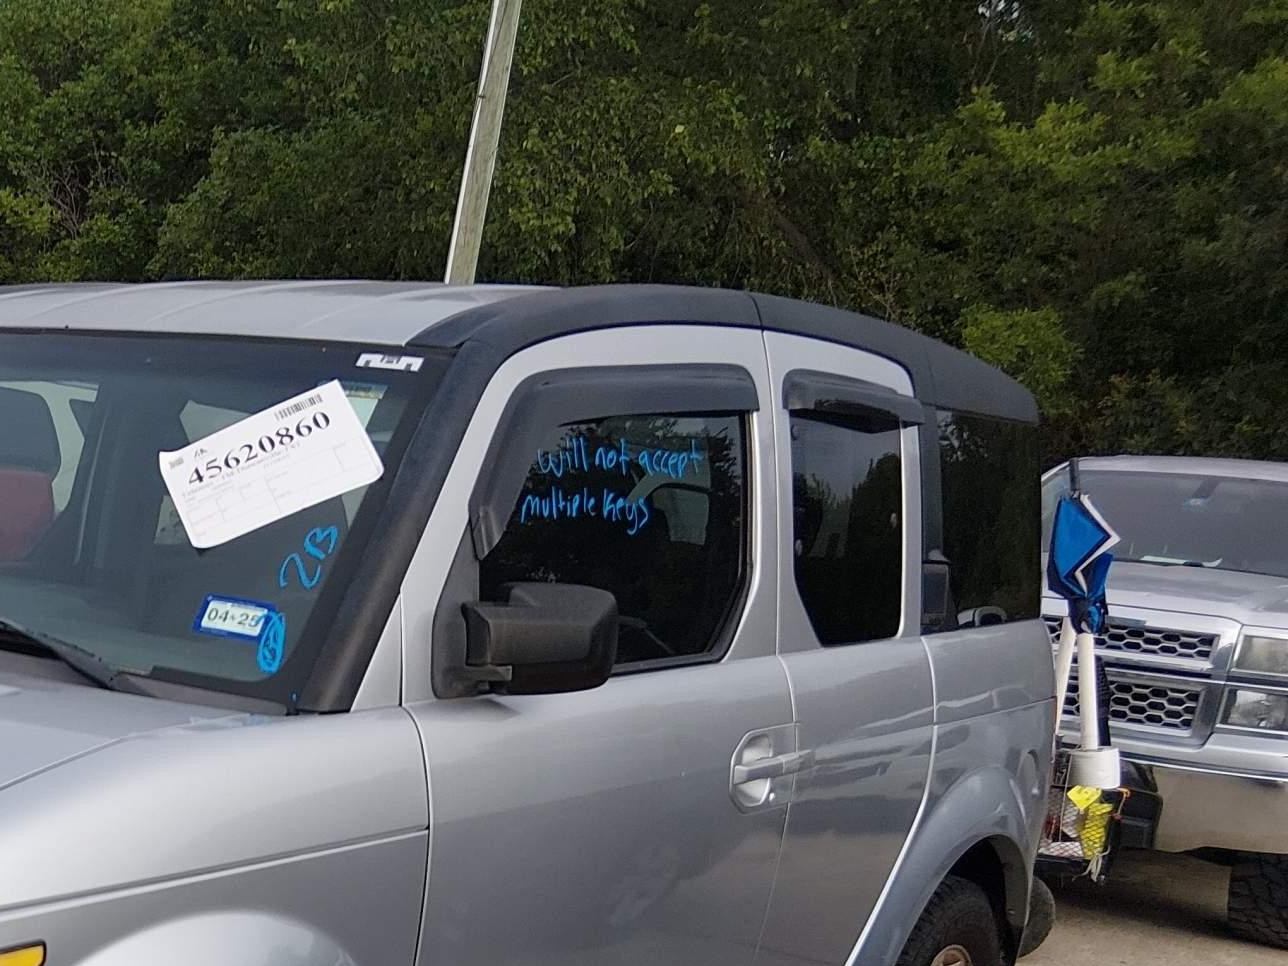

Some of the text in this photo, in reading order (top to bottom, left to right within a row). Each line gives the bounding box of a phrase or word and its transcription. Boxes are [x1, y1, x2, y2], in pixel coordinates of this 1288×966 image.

[188, 411, 330, 485] 45620860
[595, 438, 630, 475] not
[639, 439, 703, 478] accept
